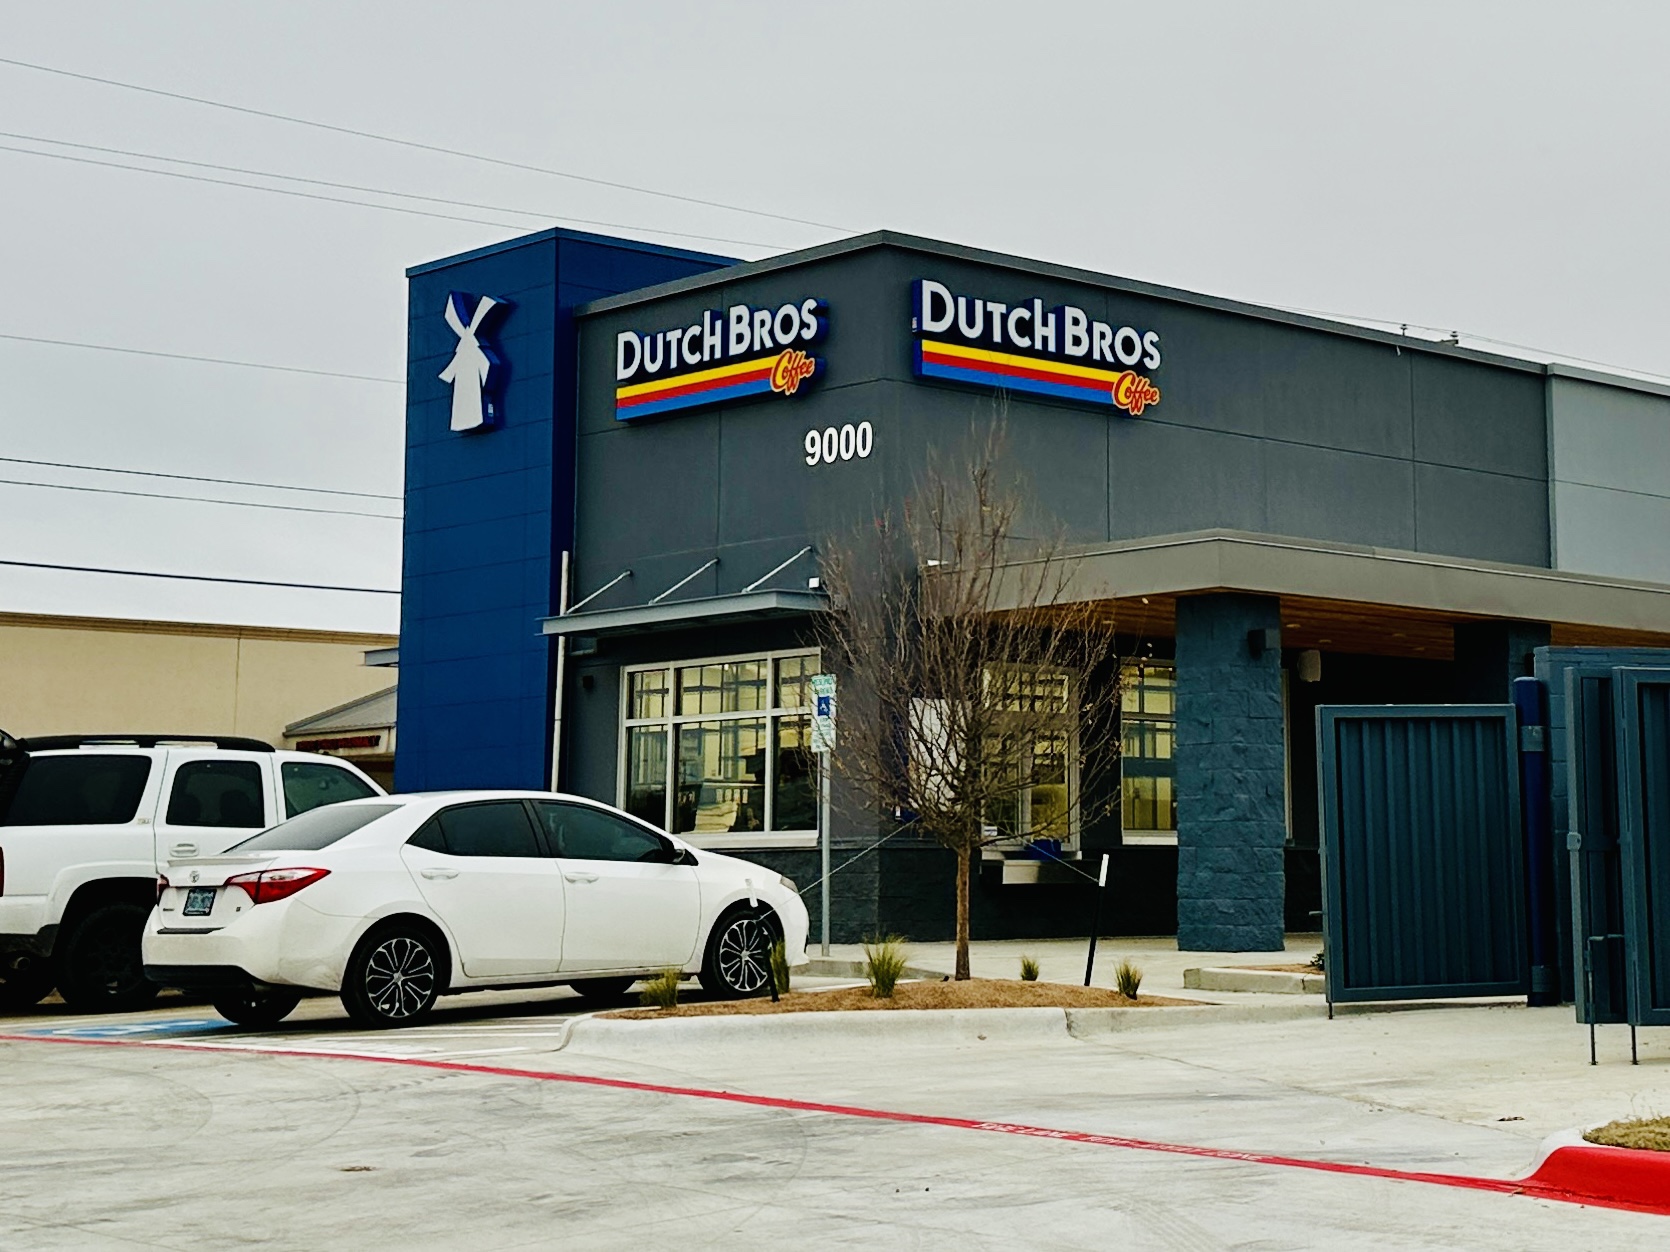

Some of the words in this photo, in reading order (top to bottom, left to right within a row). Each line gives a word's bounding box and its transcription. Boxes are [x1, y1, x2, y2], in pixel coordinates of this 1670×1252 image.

[616, 309, 723, 381] DUTCH
[729, 298, 818, 356] BROS
[922, 279, 1056, 353] DUTCH
[1064, 305, 1162, 370] BROS
[770, 348, 815, 395] Coffee
[1113, 370, 1160, 415] Coffee
[805, 421, 873, 466] 9000
